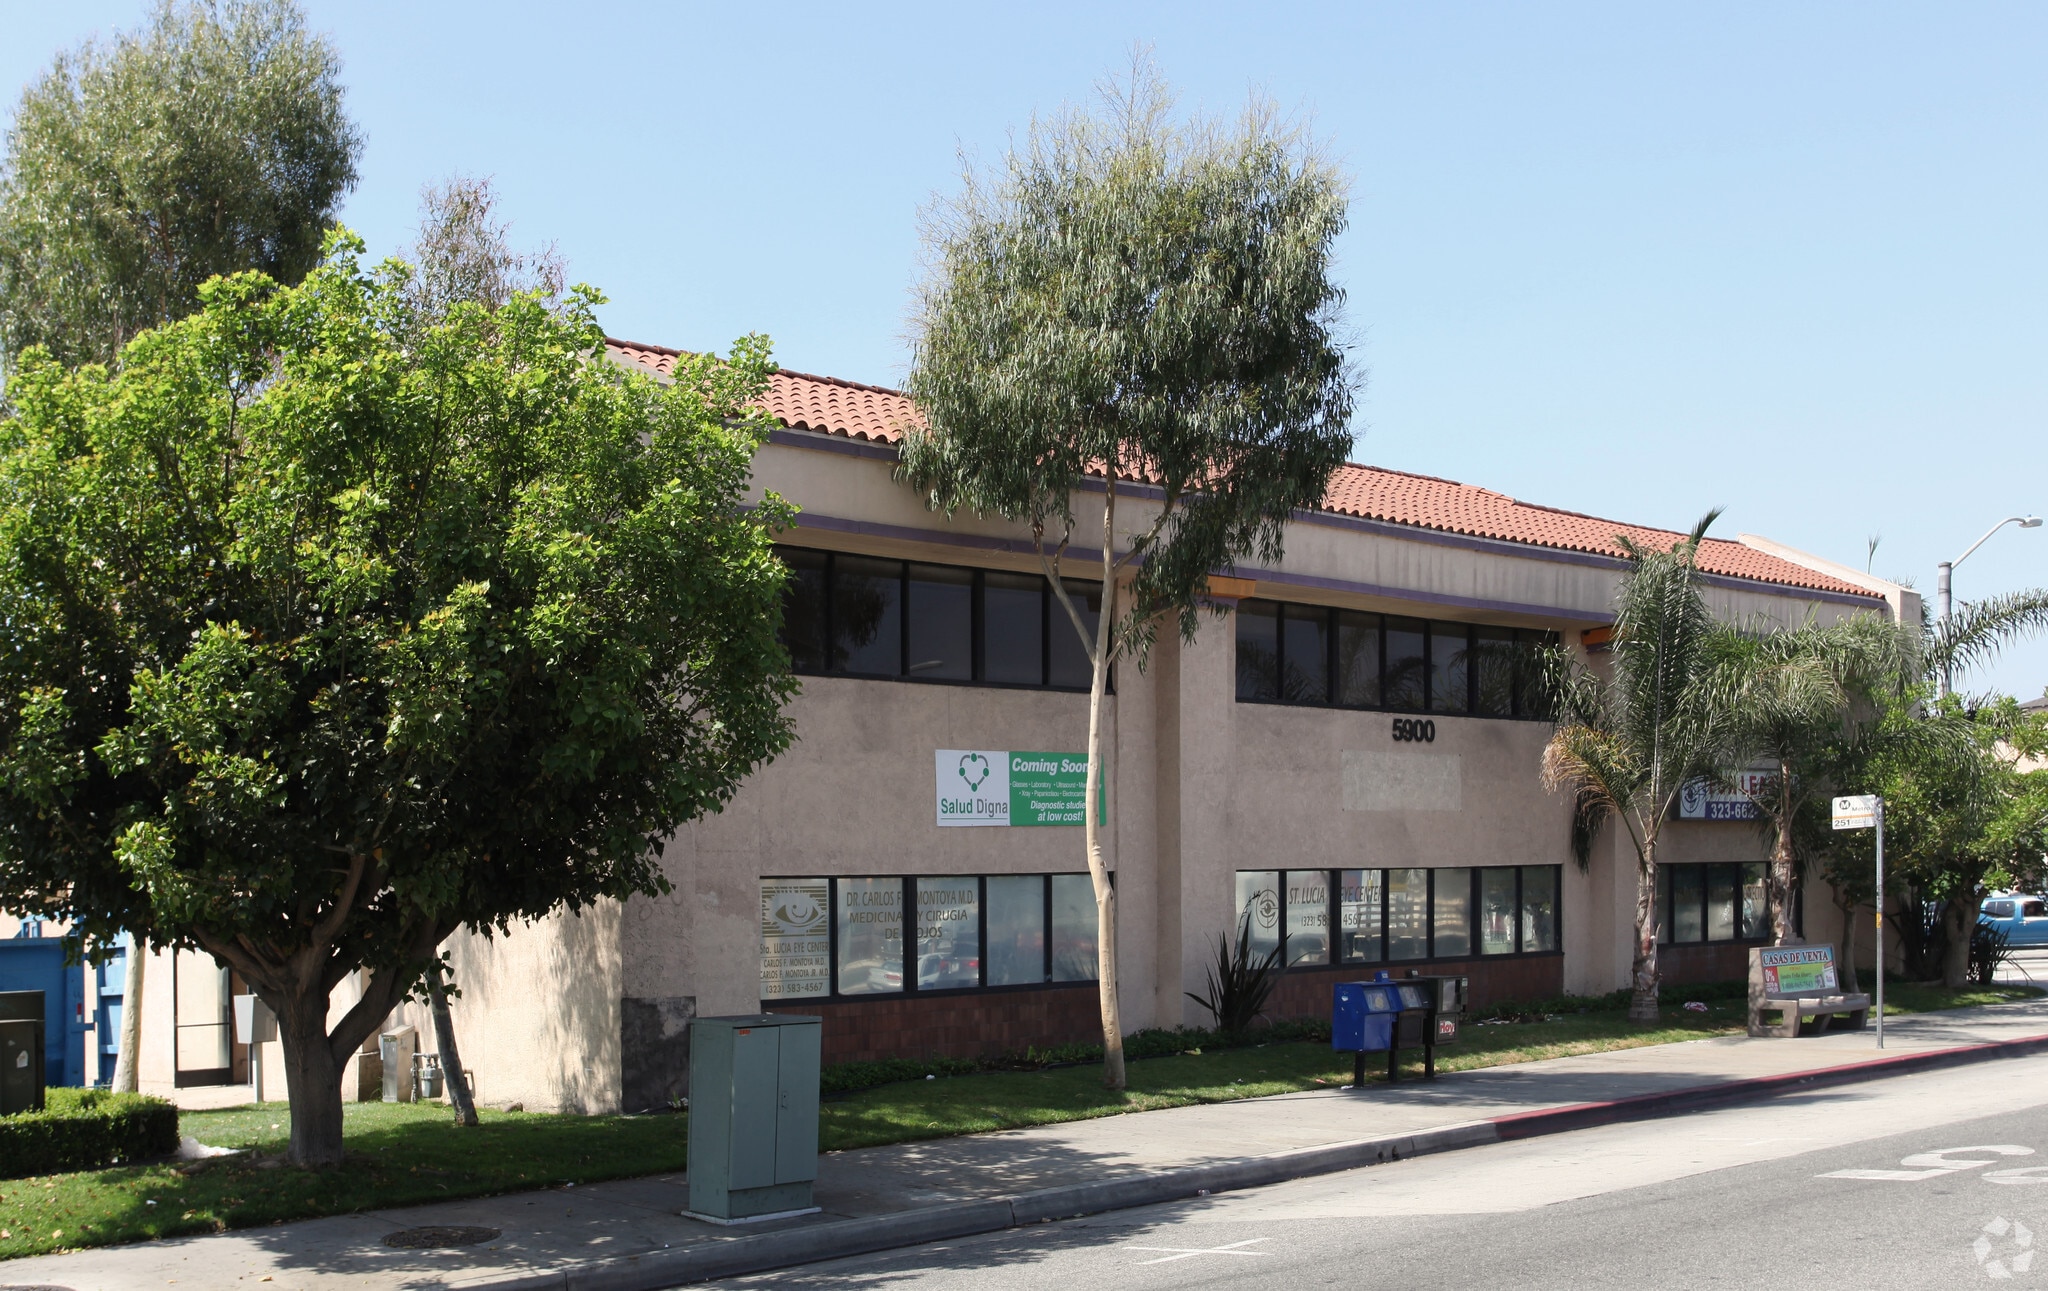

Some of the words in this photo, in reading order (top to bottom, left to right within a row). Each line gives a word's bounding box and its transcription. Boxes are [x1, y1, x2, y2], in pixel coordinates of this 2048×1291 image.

[1392, 718, 1436, 742] 5900
[1012, 757, 1058, 776] Coming
[941, 798, 973, 815] Salud
[976, 799, 1008, 818] Digna
[1030, 800, 1064, 811] Diagnostic
[1066, 801, 1087, 810] studie
[1037, 813, 1047, 822] at
[1047, 811, 1062, 821] low
[1062, 811, 1083, 821] cost!
[1834, 819, 1850, 827] 251
[846, 891, 860, 907] DR.
[862, 891, 894, 906] CARLOS
[917, 890, 956, 905] MONTOYA
[959, 890, 975, 905] M.D.
[1289, 887, 1300, 904] ST.
[1301, 886, 1325, 904] LUCIA
[1341, 886, 1354, 903] EYE
[849, 911, 903, 924] MEDICINA
[925, 909, 968, 921] CIRUGIA
[885, 928, 899, 939] DE
[917, 926, 943, 938] OJOS
[774, 942, 792, 953] LUCIA
[793, 942, 805, 952] EYE
[807, 941, 829, 953] CENTER
[763, 959, 782, 968] CARLOS
[789, 957, 814, 967] MONTOYA
[1763, 952, 1788, 966] CASAS
[1789, 952, 1801, 963] DE
[1802, 950, 1829, 962] VENTA
[785, 968, 809, 978] MONTOYA
[765, 985, 784, 994] (323)
[786, 982, 823, 993] 583-4567
